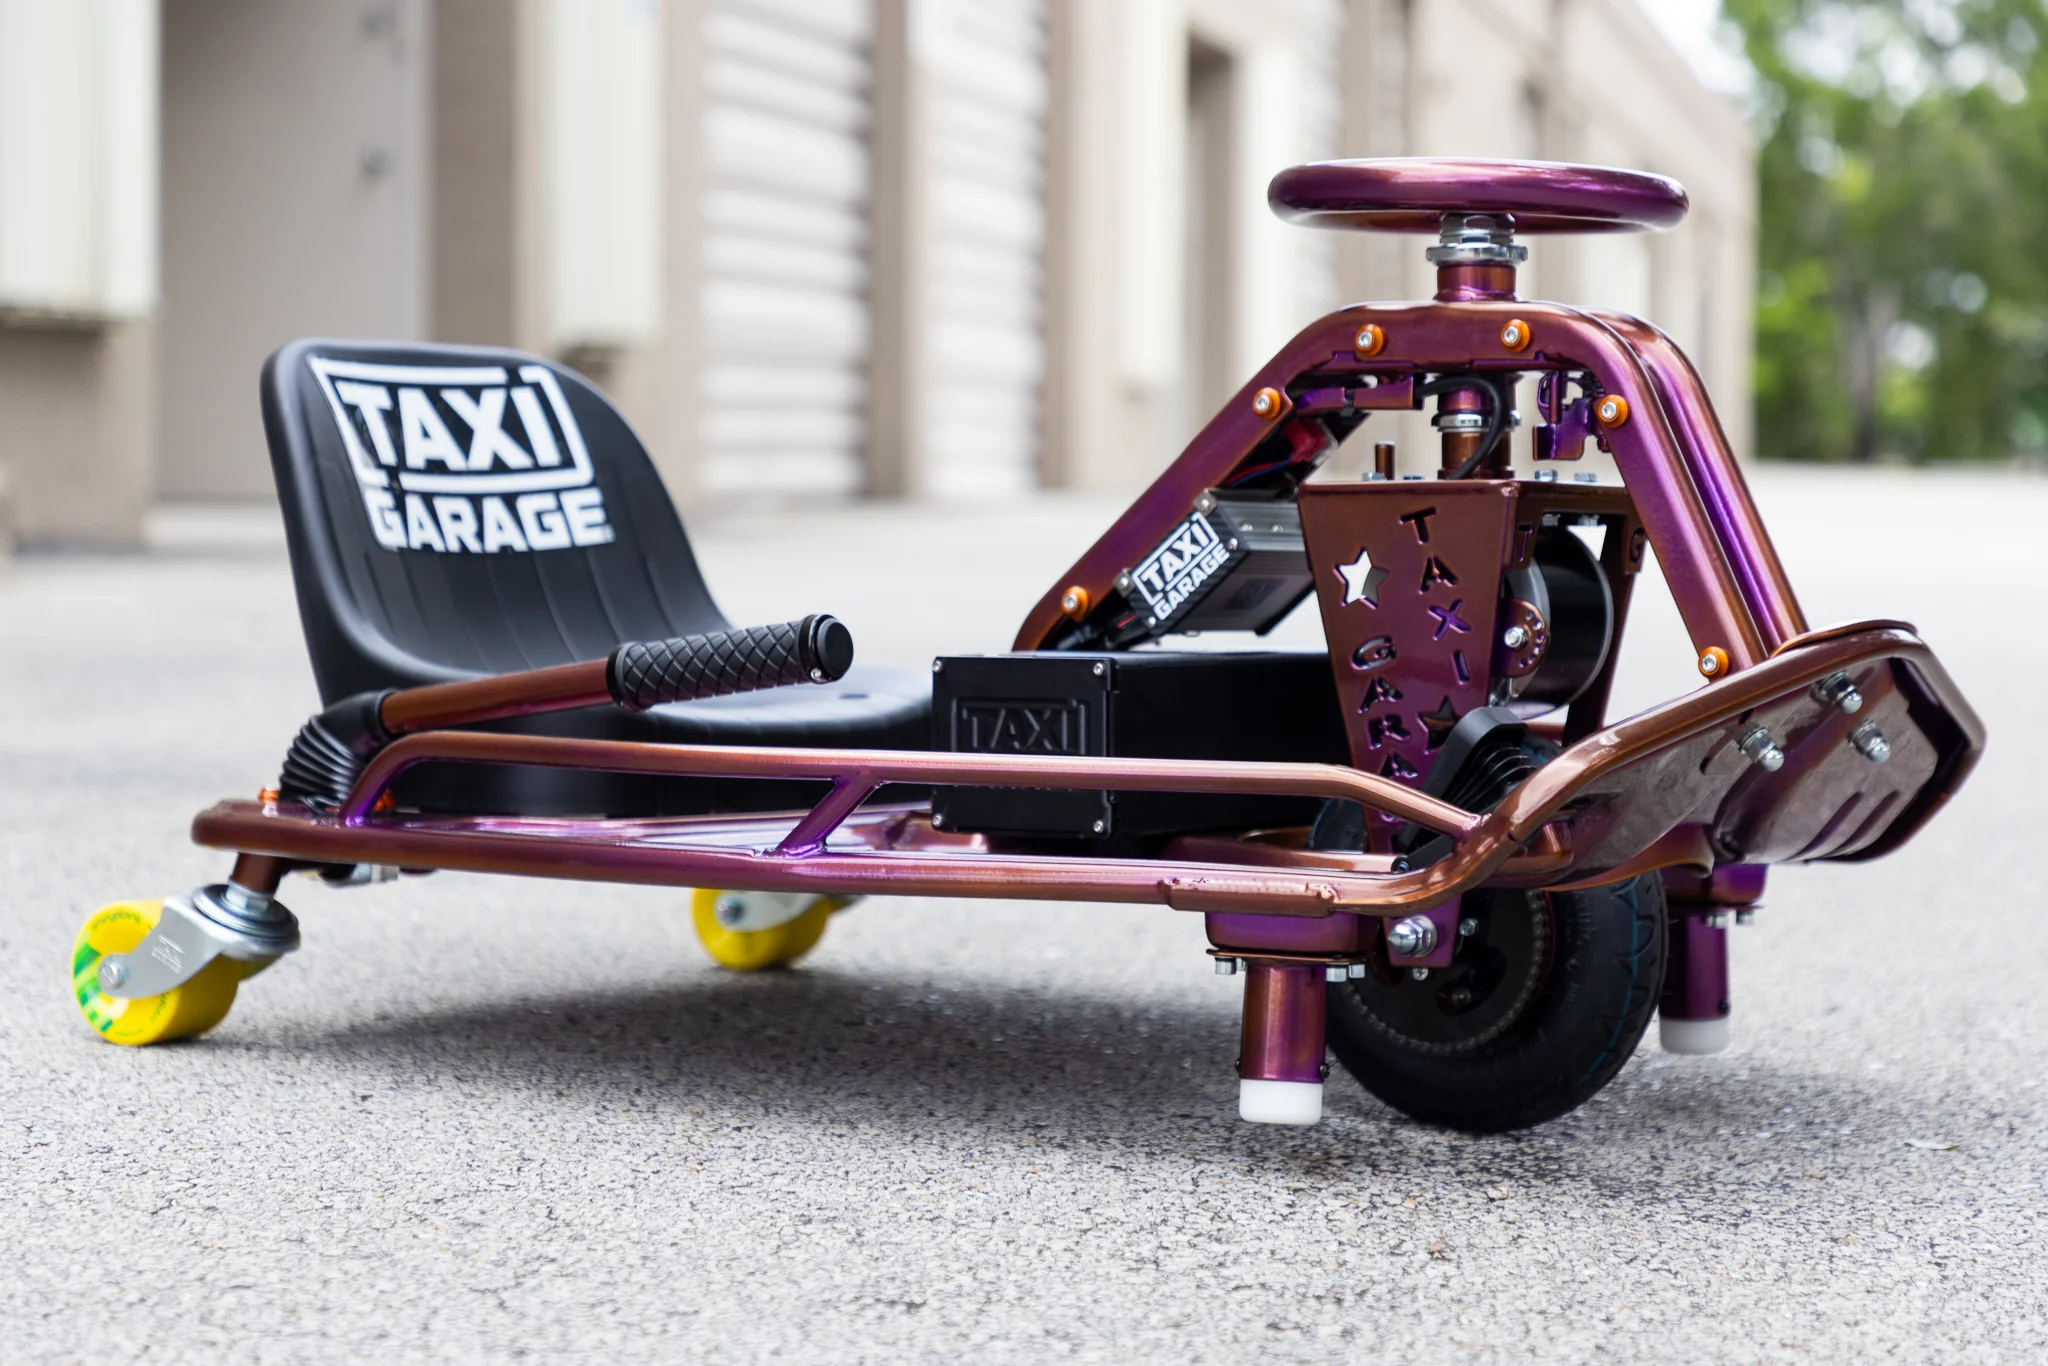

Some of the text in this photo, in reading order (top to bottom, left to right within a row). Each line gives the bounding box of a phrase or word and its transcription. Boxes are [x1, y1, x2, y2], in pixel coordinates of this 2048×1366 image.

[335, 380, 562, 471] TAXI
[363, 487, 615, 552] GARAGE
[1140, 523, 1210, 592] TAXI
[1153, 543, 1230, 621] GARAGE
[1400, 507, 1471, 685] TAXI
[961, 708, 1074, 751] TAXI
[1351, 636, 1420, 840] GARA
